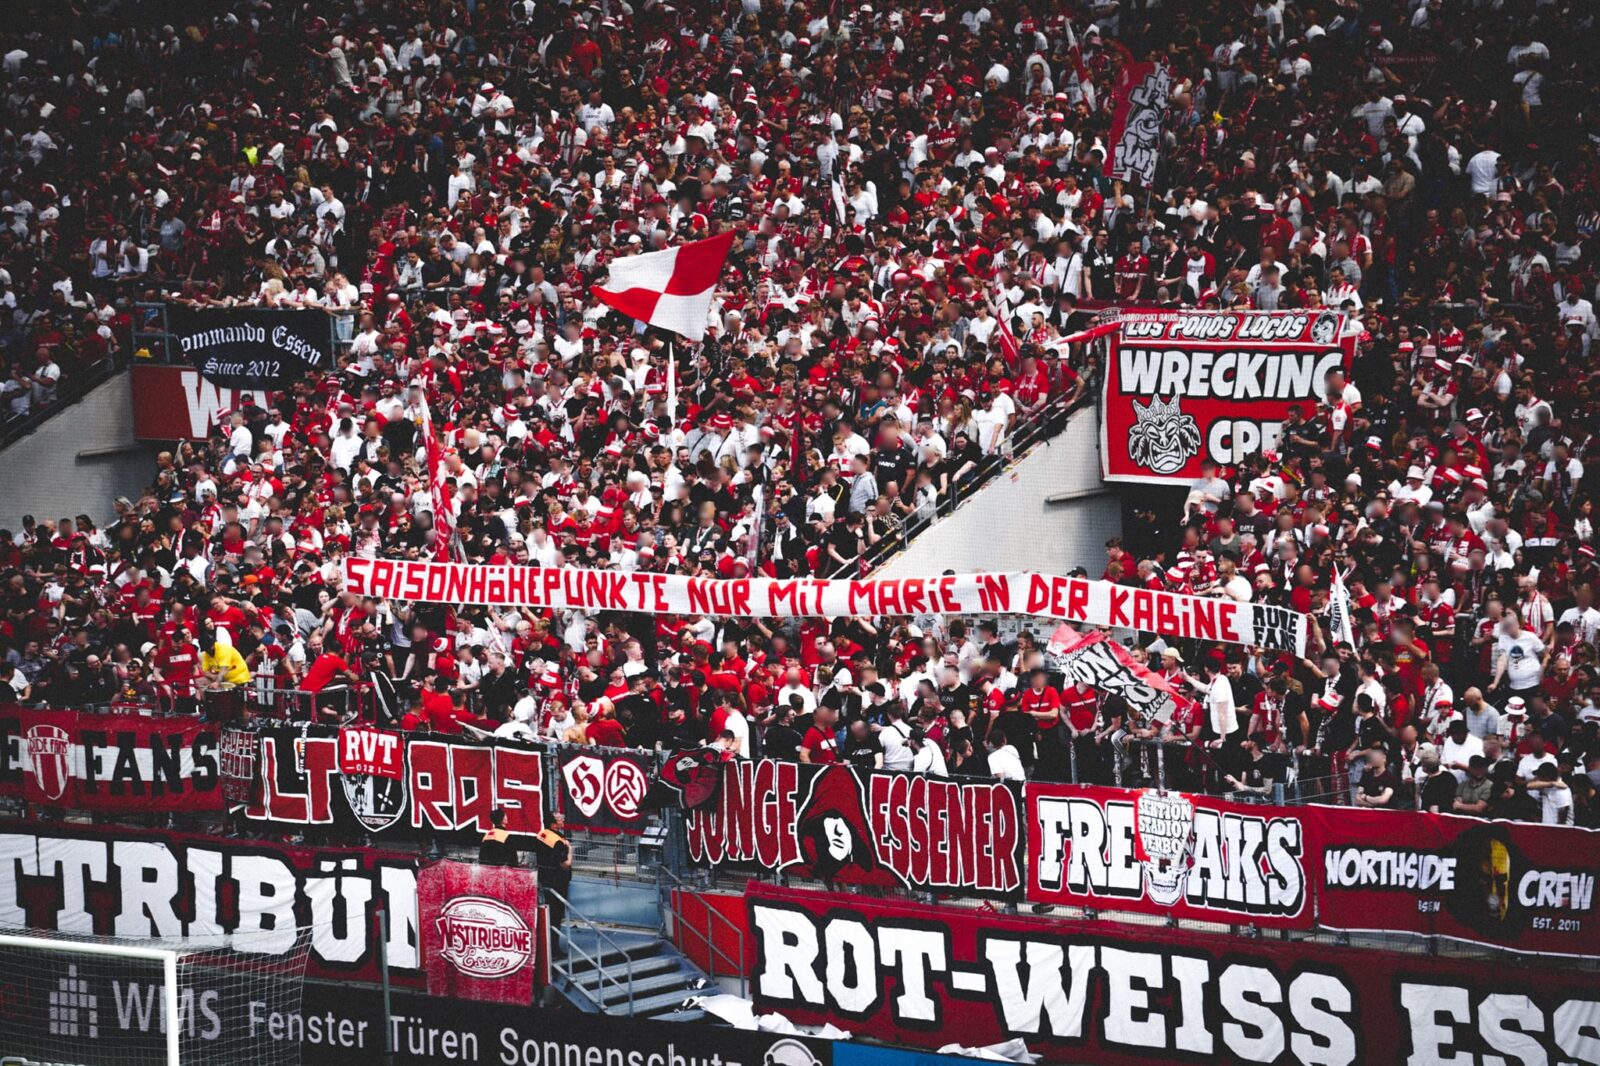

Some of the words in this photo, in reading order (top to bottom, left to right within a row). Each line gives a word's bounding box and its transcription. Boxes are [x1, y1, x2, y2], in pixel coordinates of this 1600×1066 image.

[179, 321, 266, 353] ommando
[270, 324, 323, 366] Essen
[202, 356, 245, 376] Since
[246, 360, 281, 378] 2012
[687, 577, 752, 616] NUR
[1026, 572, 1091, 622] DER
[1253, 626, 1298, 656] FANS
[80, 729, 220, 797] FANS
[345, 730, 398, 766] RVT
[868, 773, 1021, 892] ESSENER
[1138, 800, 1193, 822] SEKTION
[1141, 834, 1184, 857] VERBO
[1325, 848, 1457, 891] NORTHSIDE
[1517, 869, 1595, 911] CREW
[1532, 916, 1555, 931] EST.
[1557, 917, 1581, 932] 2011
[753, 904, 1357, 1066] ROT-WEISS
[112, 980, 222, 1040] WMS
[249, 1000, 369, 1050] Fenster
[388, 1014, 478, 1062] Türen
